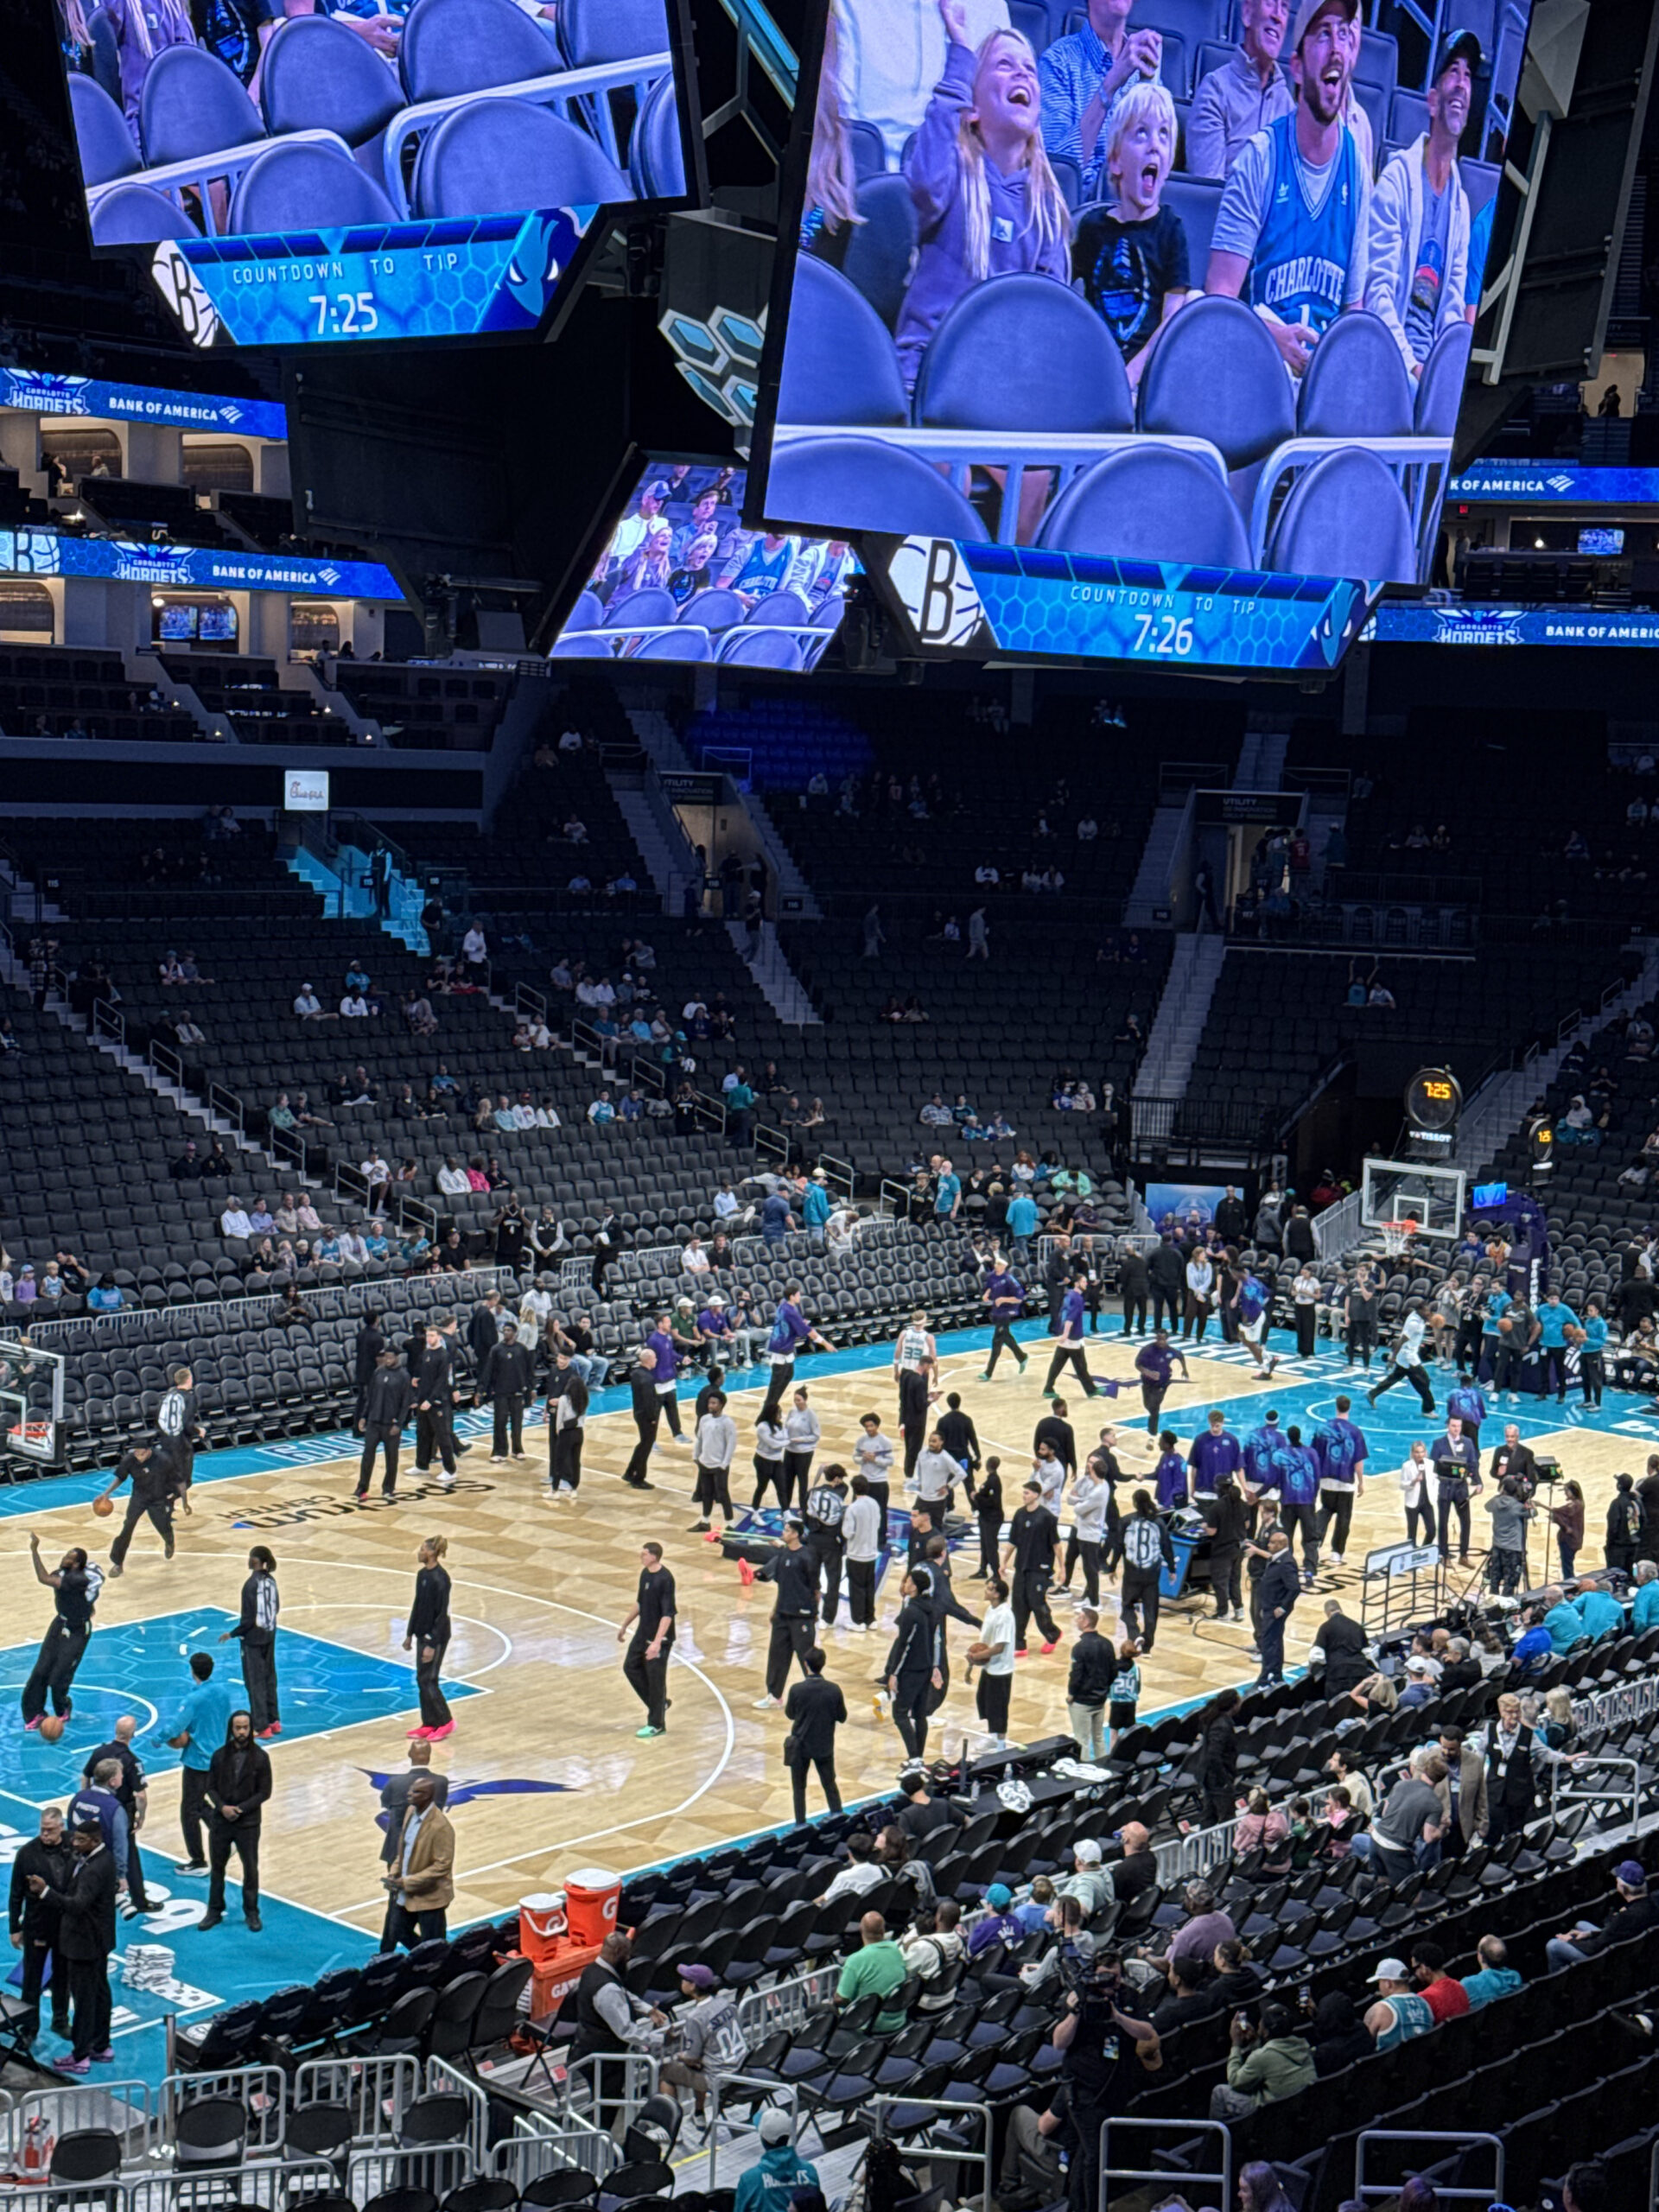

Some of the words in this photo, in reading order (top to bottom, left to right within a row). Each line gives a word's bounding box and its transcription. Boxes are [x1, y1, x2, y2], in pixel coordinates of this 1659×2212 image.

[232, 262, 343, 284] COUNTDOWN
[370, 257, 394, 276] TO
[423, 252, 457, 271] TIP
[1265, 256, 1345, 307] CHARLOTTE
[308, 291, 378, 334] 7:25
[13, 391, 86, 415] HORNETS
[109, 397, 143, 412] BANK
[146, 404, 162, 415] OF
[163, 405, 218, 422] AMERICA
[1461, 480, 1480, 491] OF
[1481, 480, 1544, 492] AMERICA
[119, 563, 189, 584] HORNETS
[213, 565, 245, 579] BANK
[248, 569, 264, 580] OF
[264, 569, 316, 585] AMERICA
[1071, 585, 1174, 608] COUNTDOWN
[1196, 596, 1213, 612] TO
[1233, 599, 1255, 614] TIP
[1134, 613, 1193, 655] 7:26
[1440, 628, 1517, 645] HORNETS
[1546, 626, 1585, 637] BANK
[1587, 626, 1606, 638] OF
[1422, 1081, 1452, 1100] 7:25
[1420, 1132, 1452, 1142] TISSOT
[1115, 1677, 1135, 1694] 24
[602, 1896, 618, 1920] G
